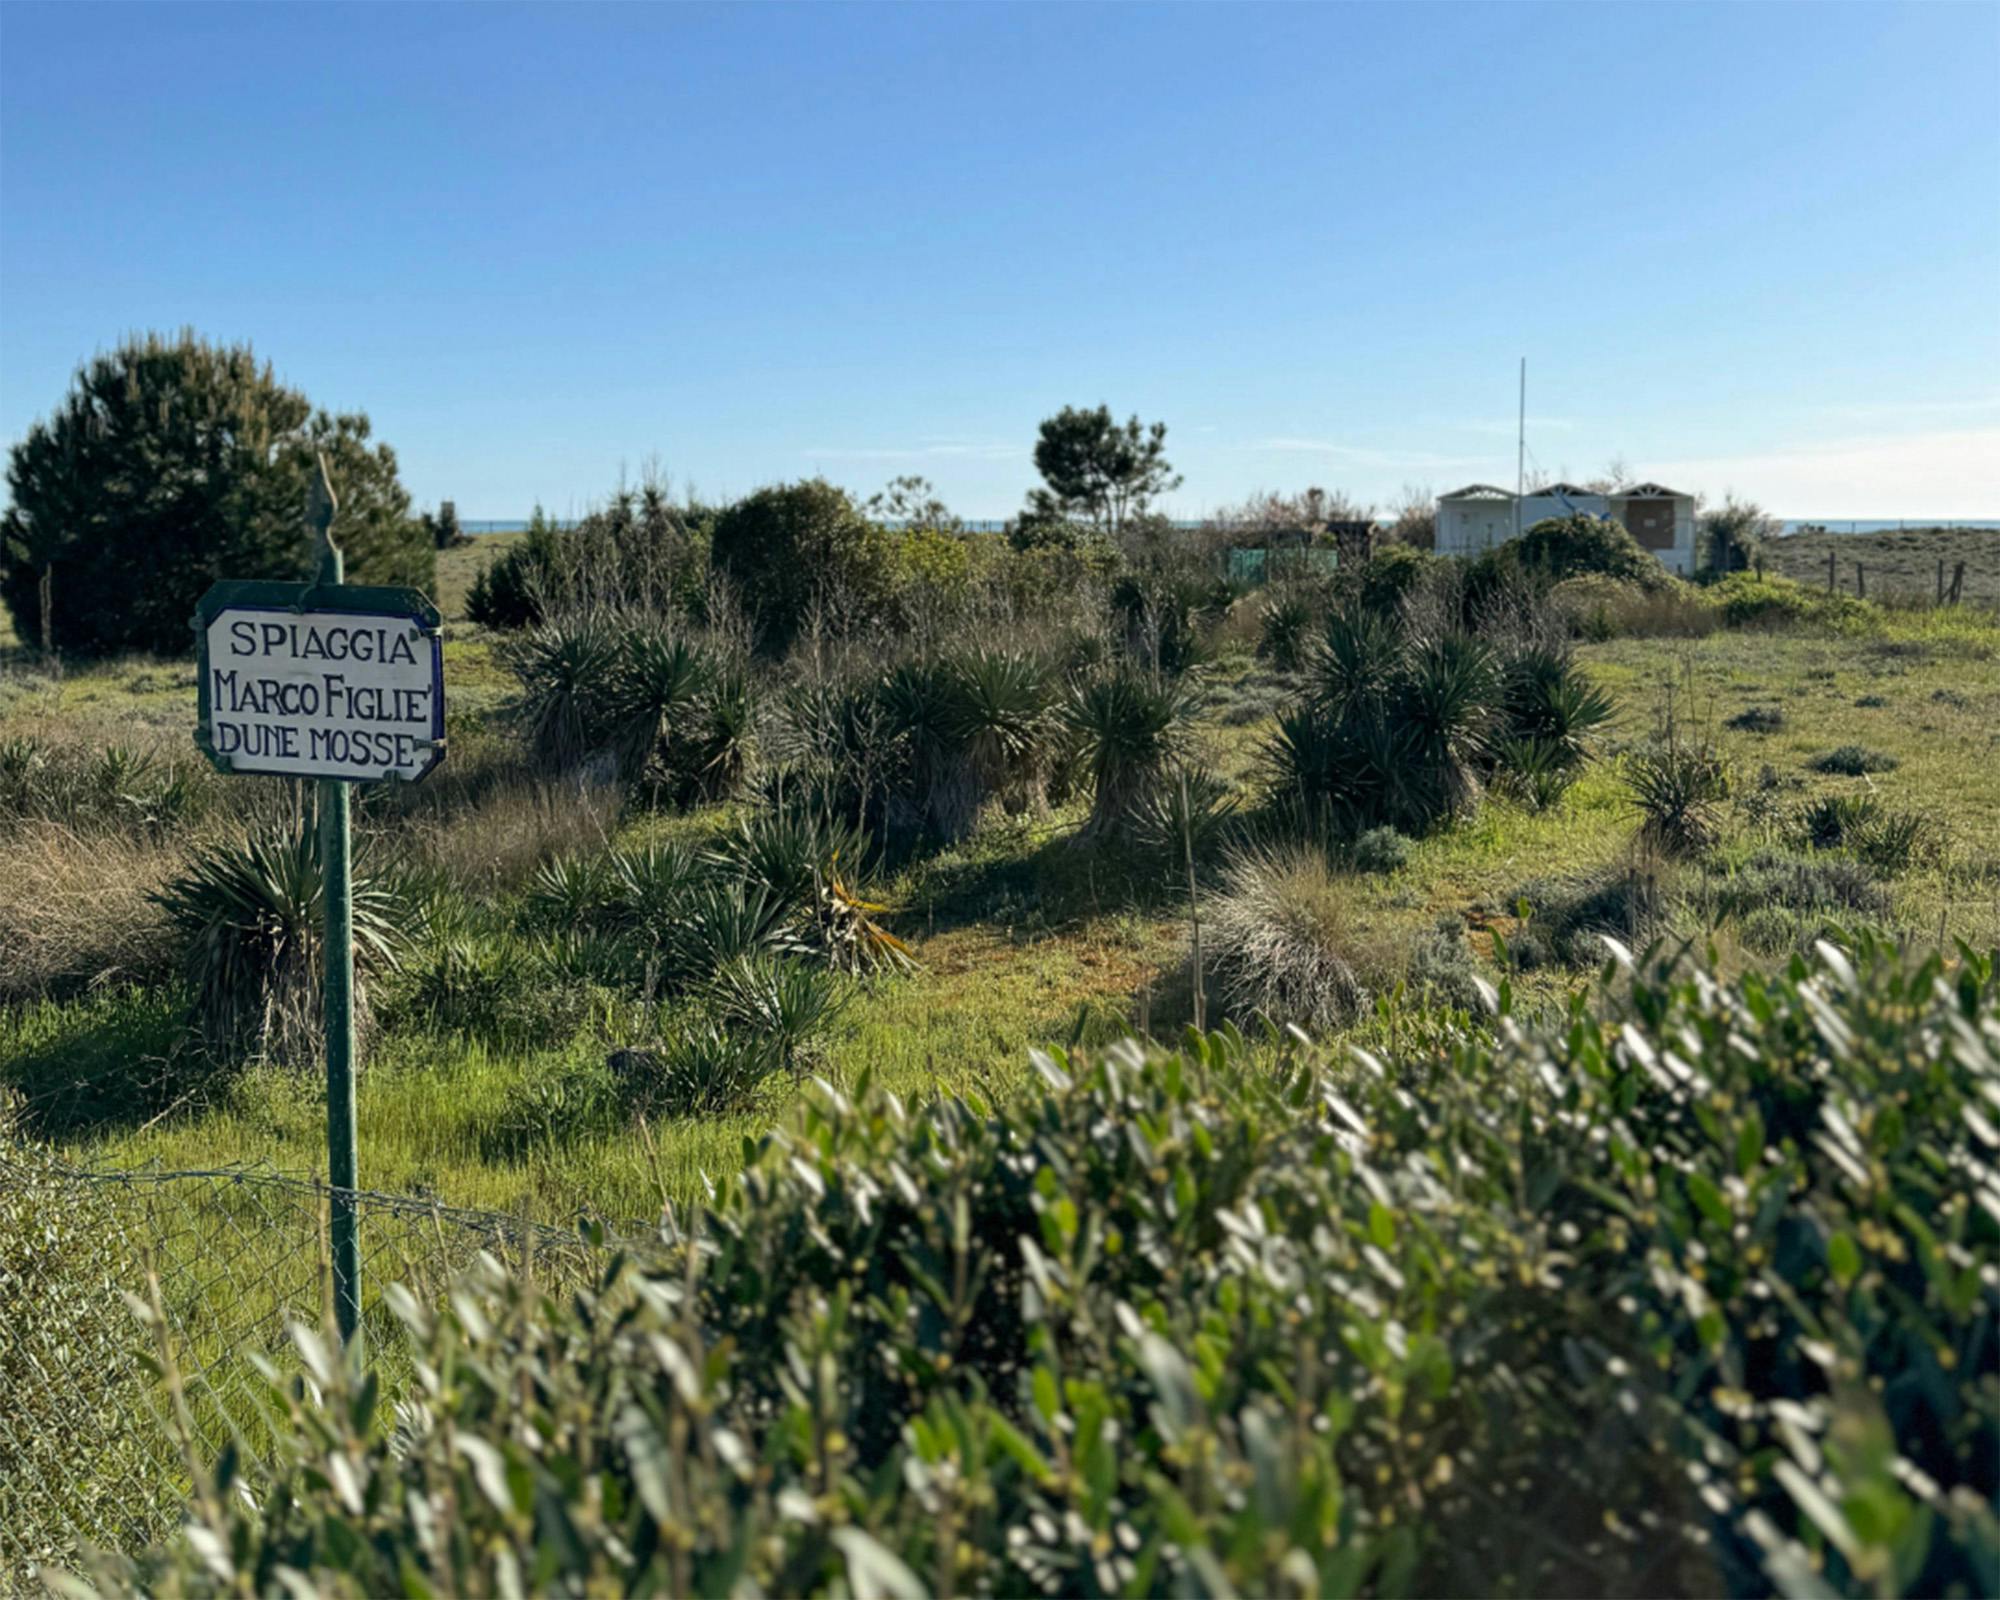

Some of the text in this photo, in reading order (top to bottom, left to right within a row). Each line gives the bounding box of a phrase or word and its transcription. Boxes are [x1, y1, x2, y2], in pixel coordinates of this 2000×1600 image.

[230, 621, 417, 665] SPIAGGIA
[217, 721, 415, 767] DUNE MOSSE
